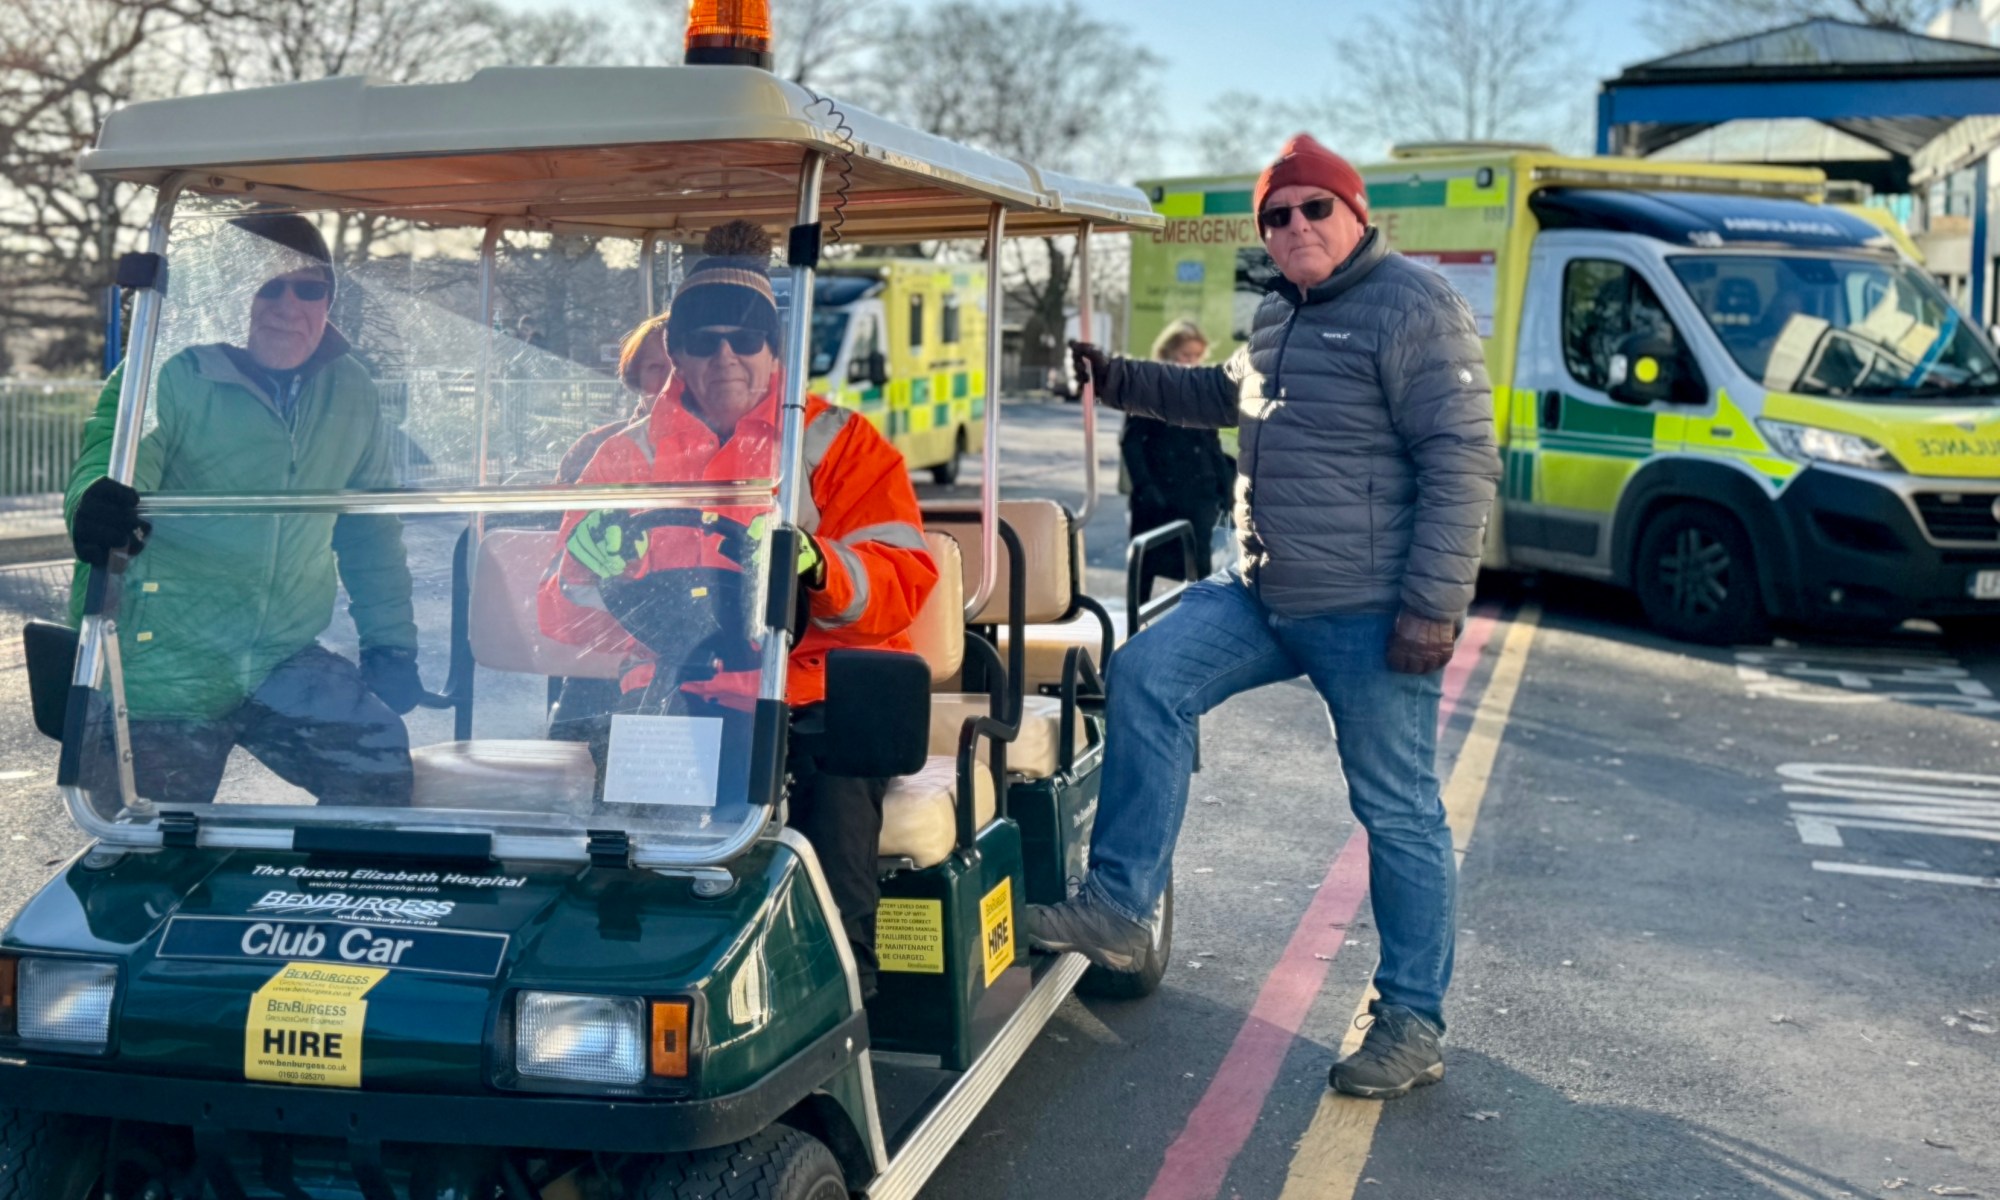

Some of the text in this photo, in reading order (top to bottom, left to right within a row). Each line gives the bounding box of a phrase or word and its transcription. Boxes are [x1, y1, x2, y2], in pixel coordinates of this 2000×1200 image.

[1152, 219, 1260, 244] EMERGENC
[252, 864, 527, 888] The Queen Elizabeth Hospital
[308, 881, 347, 890] working
[358, 883, 415, 893] partnership
[416, 885, 439, 893] with
[337, 914, 439, 927] www.benburgess.co.uk
[241, 923, 413, 964] Club Car
[988, 915, 1009, 959] HIRE
[885, 943, 934, 951] MAINTENANCE
[272, 985, 352, 998] www.benburgess.co.uk
[263, 1028, 342, 1059] HIRE
[257, 1059, 347, 1072] www.benburgess.co.uk
